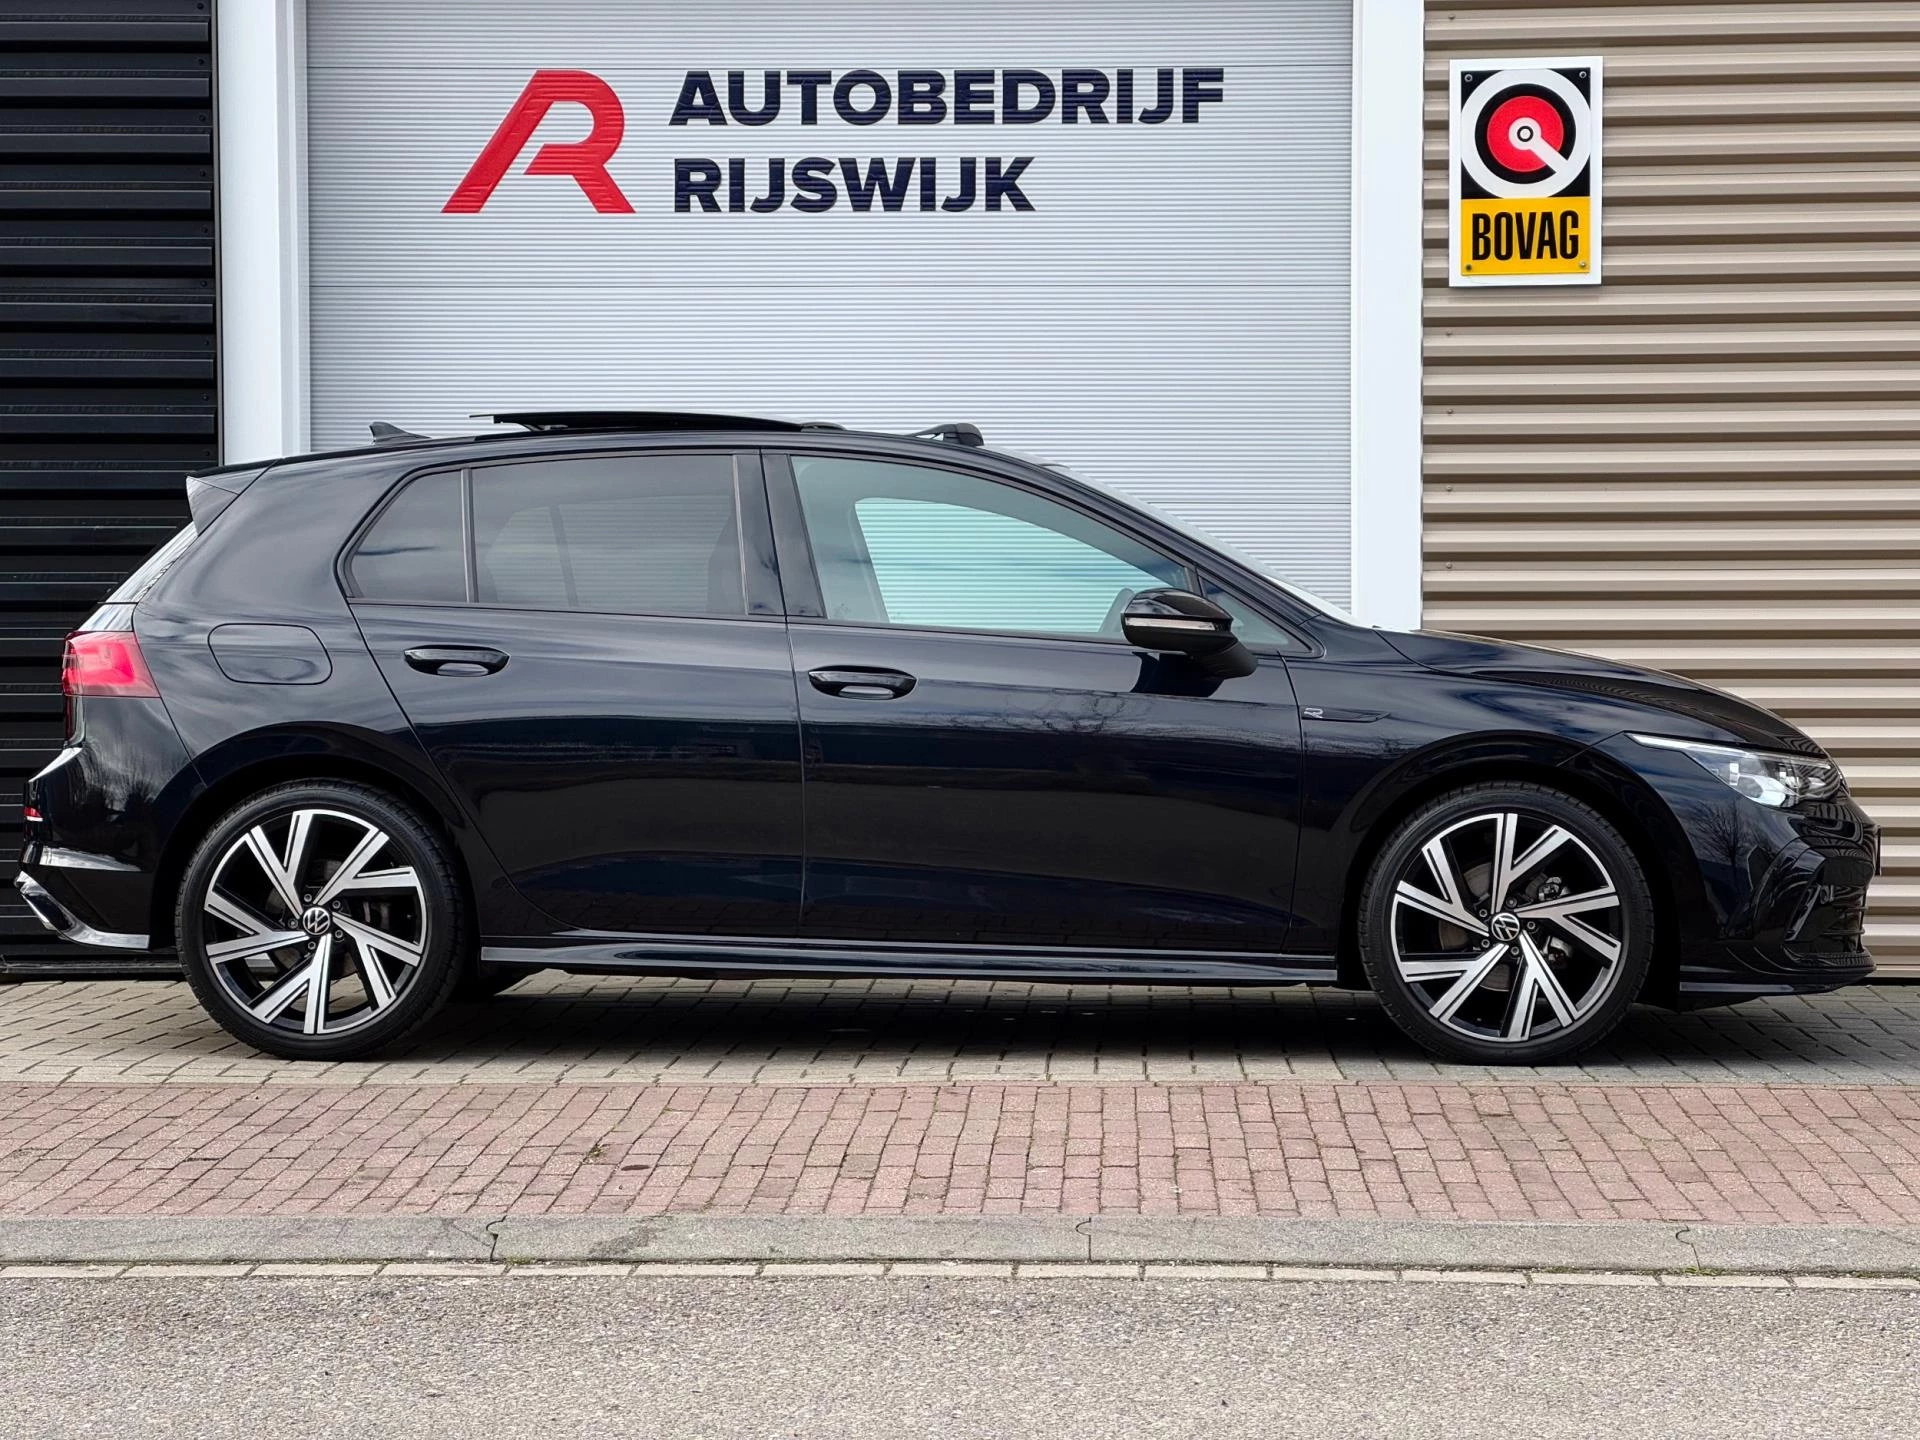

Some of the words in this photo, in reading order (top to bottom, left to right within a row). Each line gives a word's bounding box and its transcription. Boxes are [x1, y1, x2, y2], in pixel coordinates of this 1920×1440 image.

[669, 68, 1224, 126] AUTOBEDRIJF
[674, 157, 1036, 213] RIJSWIJK
[1472, 210, 1579, 261] BOVAG
